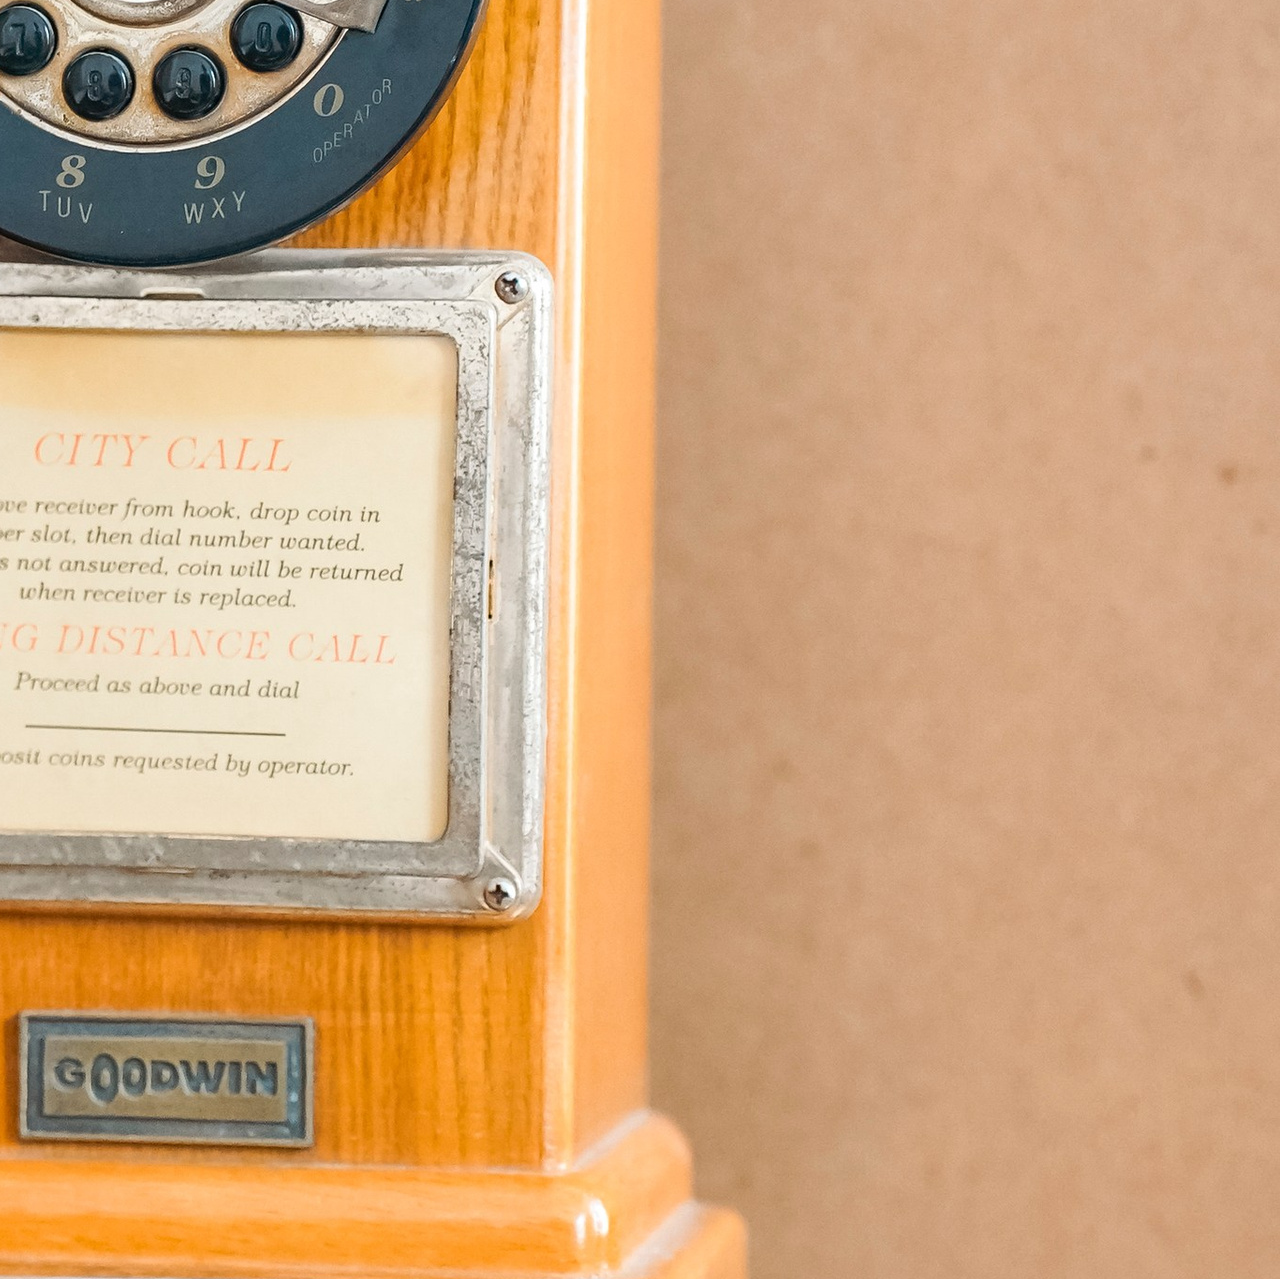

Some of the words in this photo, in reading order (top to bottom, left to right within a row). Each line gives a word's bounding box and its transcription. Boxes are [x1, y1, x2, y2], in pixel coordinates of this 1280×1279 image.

[313, 83, 345, 118] 0
[312, 78, 393, 164] OPERATOR
[55, 154, 87, 189] 8
[194, 155, 226, 190] 9
[38, 190, 93, 224] TUV
[183, 190, 246, 224] WXY
[33, 431, 151, 467] CITY
[166, 435, 294, 472] CALL
[34, 498, 119, 516] receiver
[121, 497, 174, 522] from
[182, 499, 241, 520] hook,
[250, 502, 300, 525] drop
[306, 505, 353, 522] coin
[360, 506, 381, 523] in
[30, 524, 76, 544] slot,
[86, 526, 133, 546] then
[140, 527, 181, 547] dial
[189, 530, 273, 549] number
[279, 533, 365, 552] wanted.
[17, 556, 51, 572] not
[59, 556, 168, 576] answered,
[178, 559, 222, 577] coin
[230, 559, 270, 578] will
[277, 560, 302, 579] be
[309, 563, 404, 582] returned
[20, 582, 75, 601] when
[83, 586, 167, 604] receiver
[174, 588, 191, 605] is
[199, 588, 296, 611] replaced.
[56, 624, 271, 661] DISTANCE
[288, 632, 397, 665] CALL
[14, 671, 100, 693] Proceed
[107, 681, 131, 694] as
[139, 676, 203, 696] above
[209, 680, 251, 698] and
[258, 680, 300, 700] dial
[48, 750, 105, 767] coins
[113, 753, 218, 774] requested
[225, 754, 252, 777] by
[257, 758, 354, 779] operator.
[53, 1052, 279, 1107] GOODWIN
